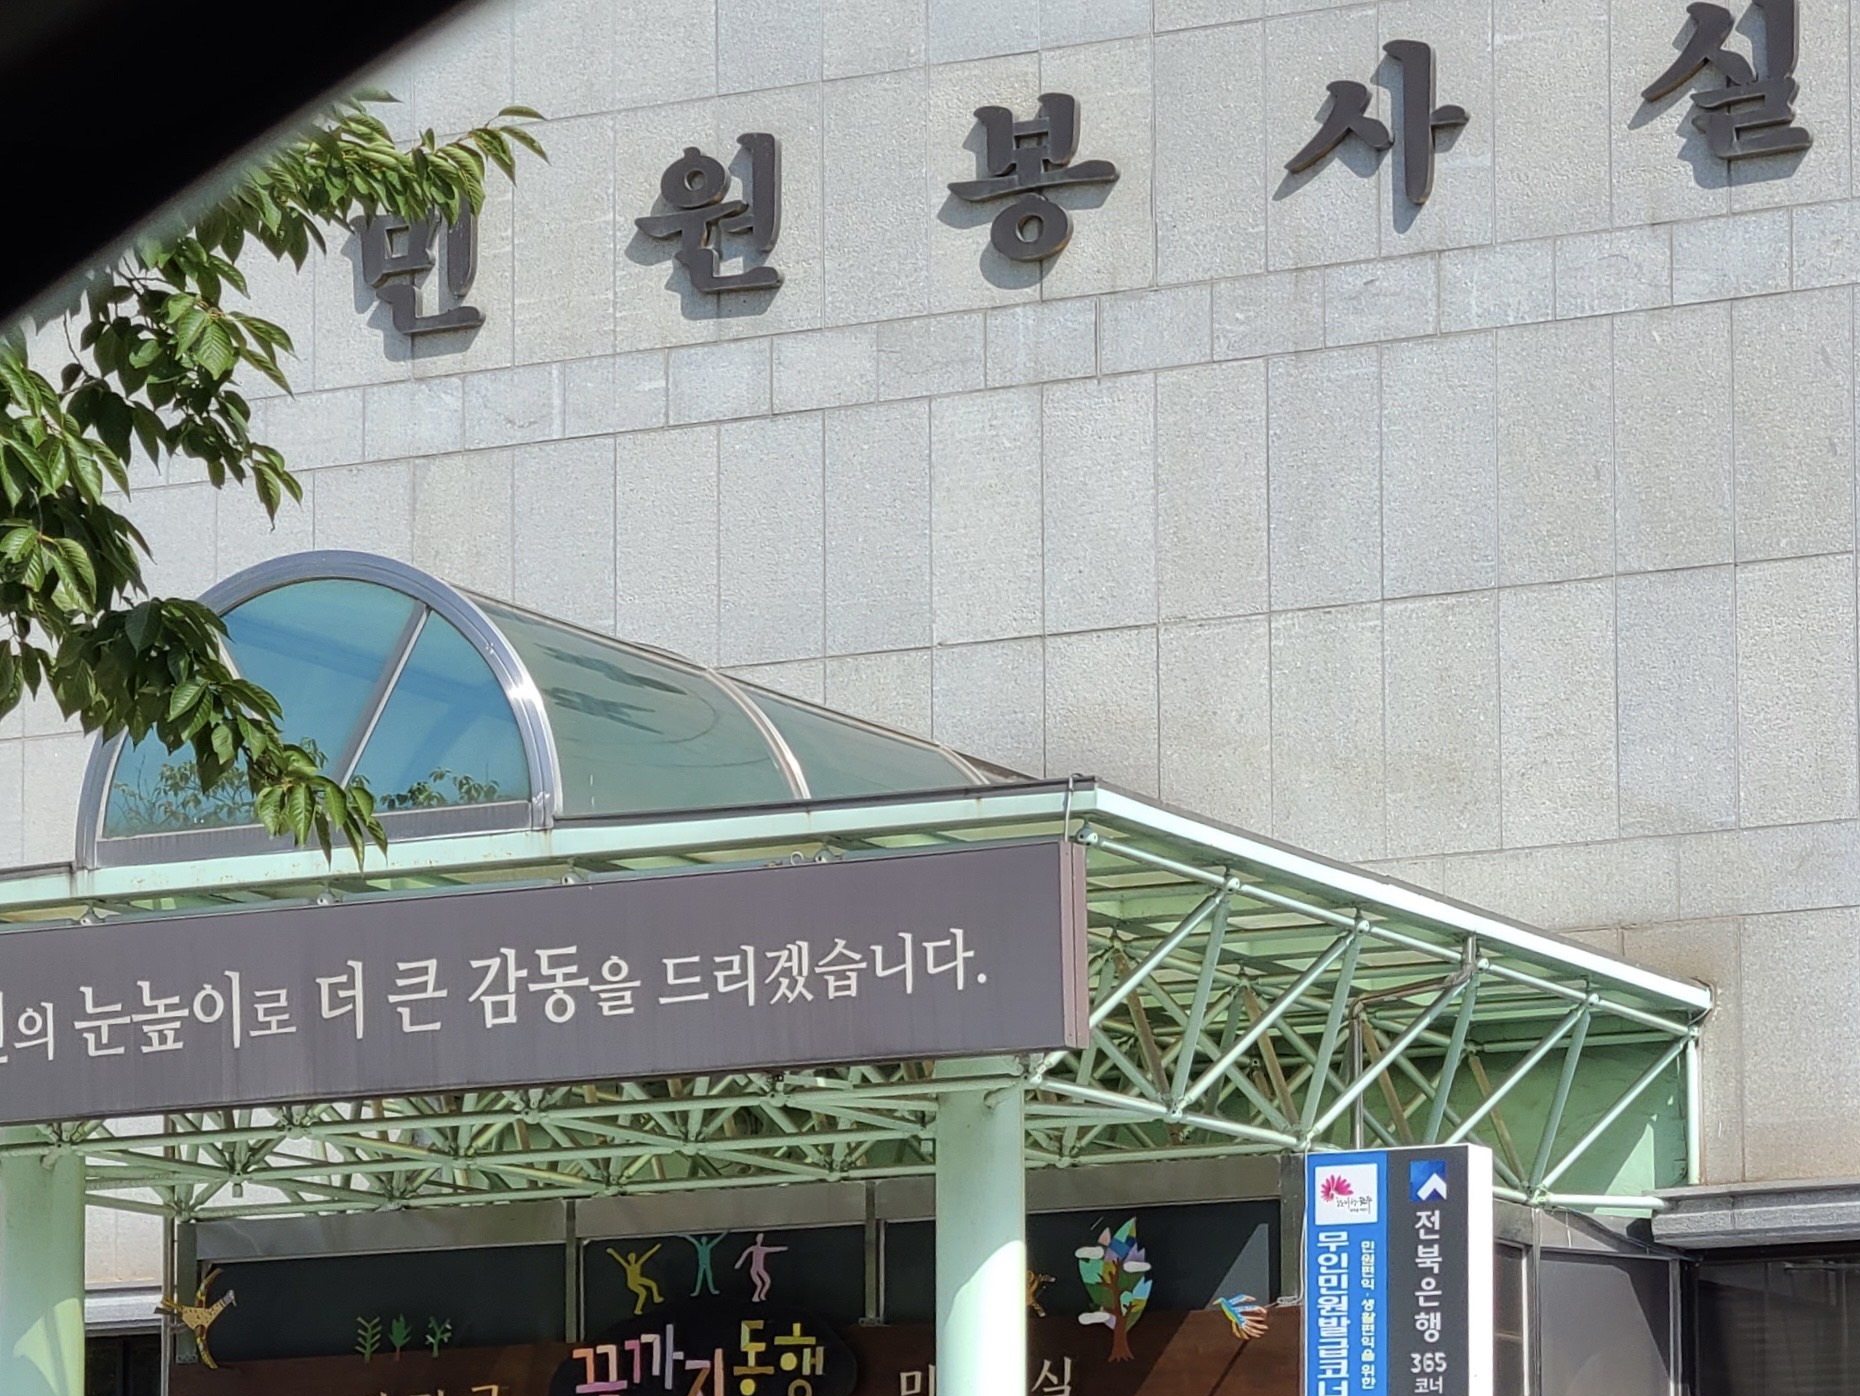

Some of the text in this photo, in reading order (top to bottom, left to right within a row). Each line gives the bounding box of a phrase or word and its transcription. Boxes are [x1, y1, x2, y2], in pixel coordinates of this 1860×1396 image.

[74, 970, 297, 1057] 눈높이로
[316, 960, 366, 1040] 더
[386, 959, 448, 1034] 큰
[467, 944, 642, 1030] 감동을
[660, 927, 987, 1010] 드리겠습니다.
[1414, 1208, 1443, 1343] 전북은행
[1410, 1351, 1447, 1374] 365
[1414, 1375, 1443, 1394] 코너
